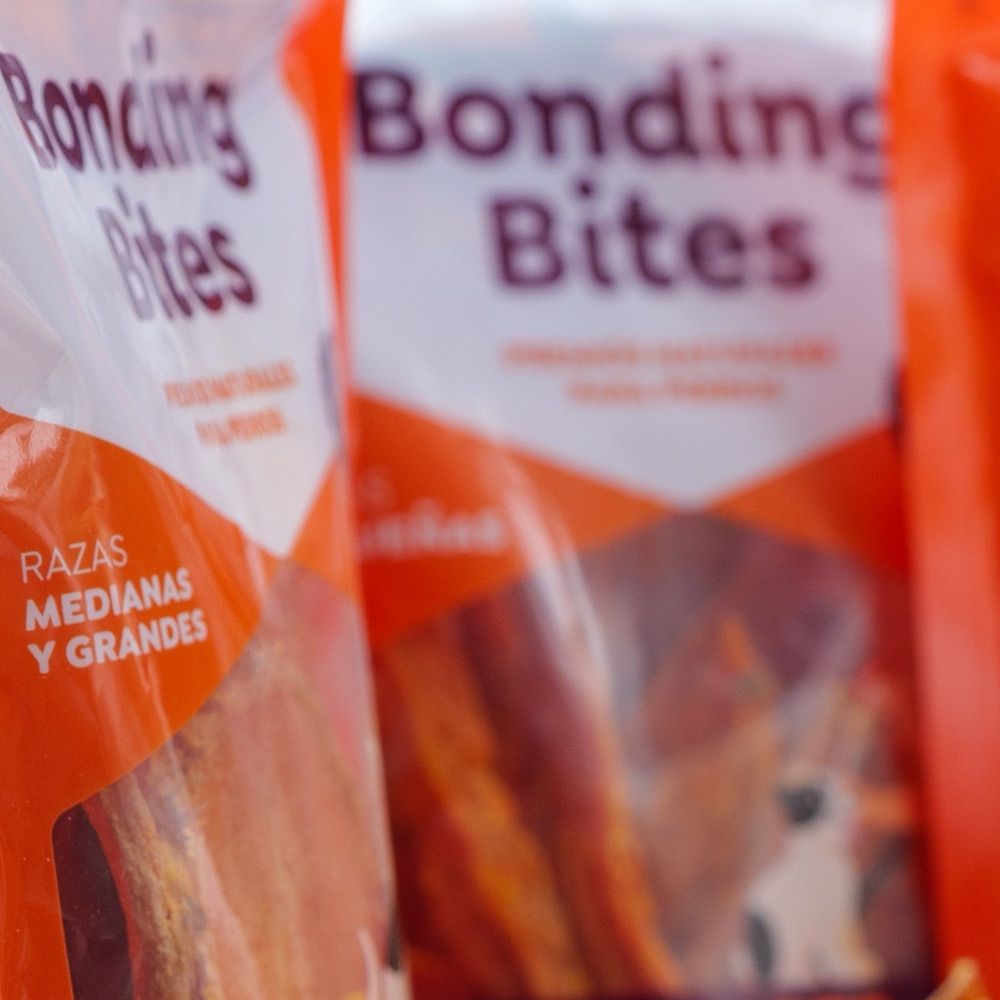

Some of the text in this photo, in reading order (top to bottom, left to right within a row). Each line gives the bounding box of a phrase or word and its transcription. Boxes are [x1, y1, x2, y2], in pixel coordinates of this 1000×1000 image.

[353, 48, 888, 192] Bonding
[485, 178, 818, 294] Bites
[20, 534, 128, 583] RAZAS
[25, 567, 193, 631] MEDIANAS
[27, 609, 208, 674] Y GRANDES
